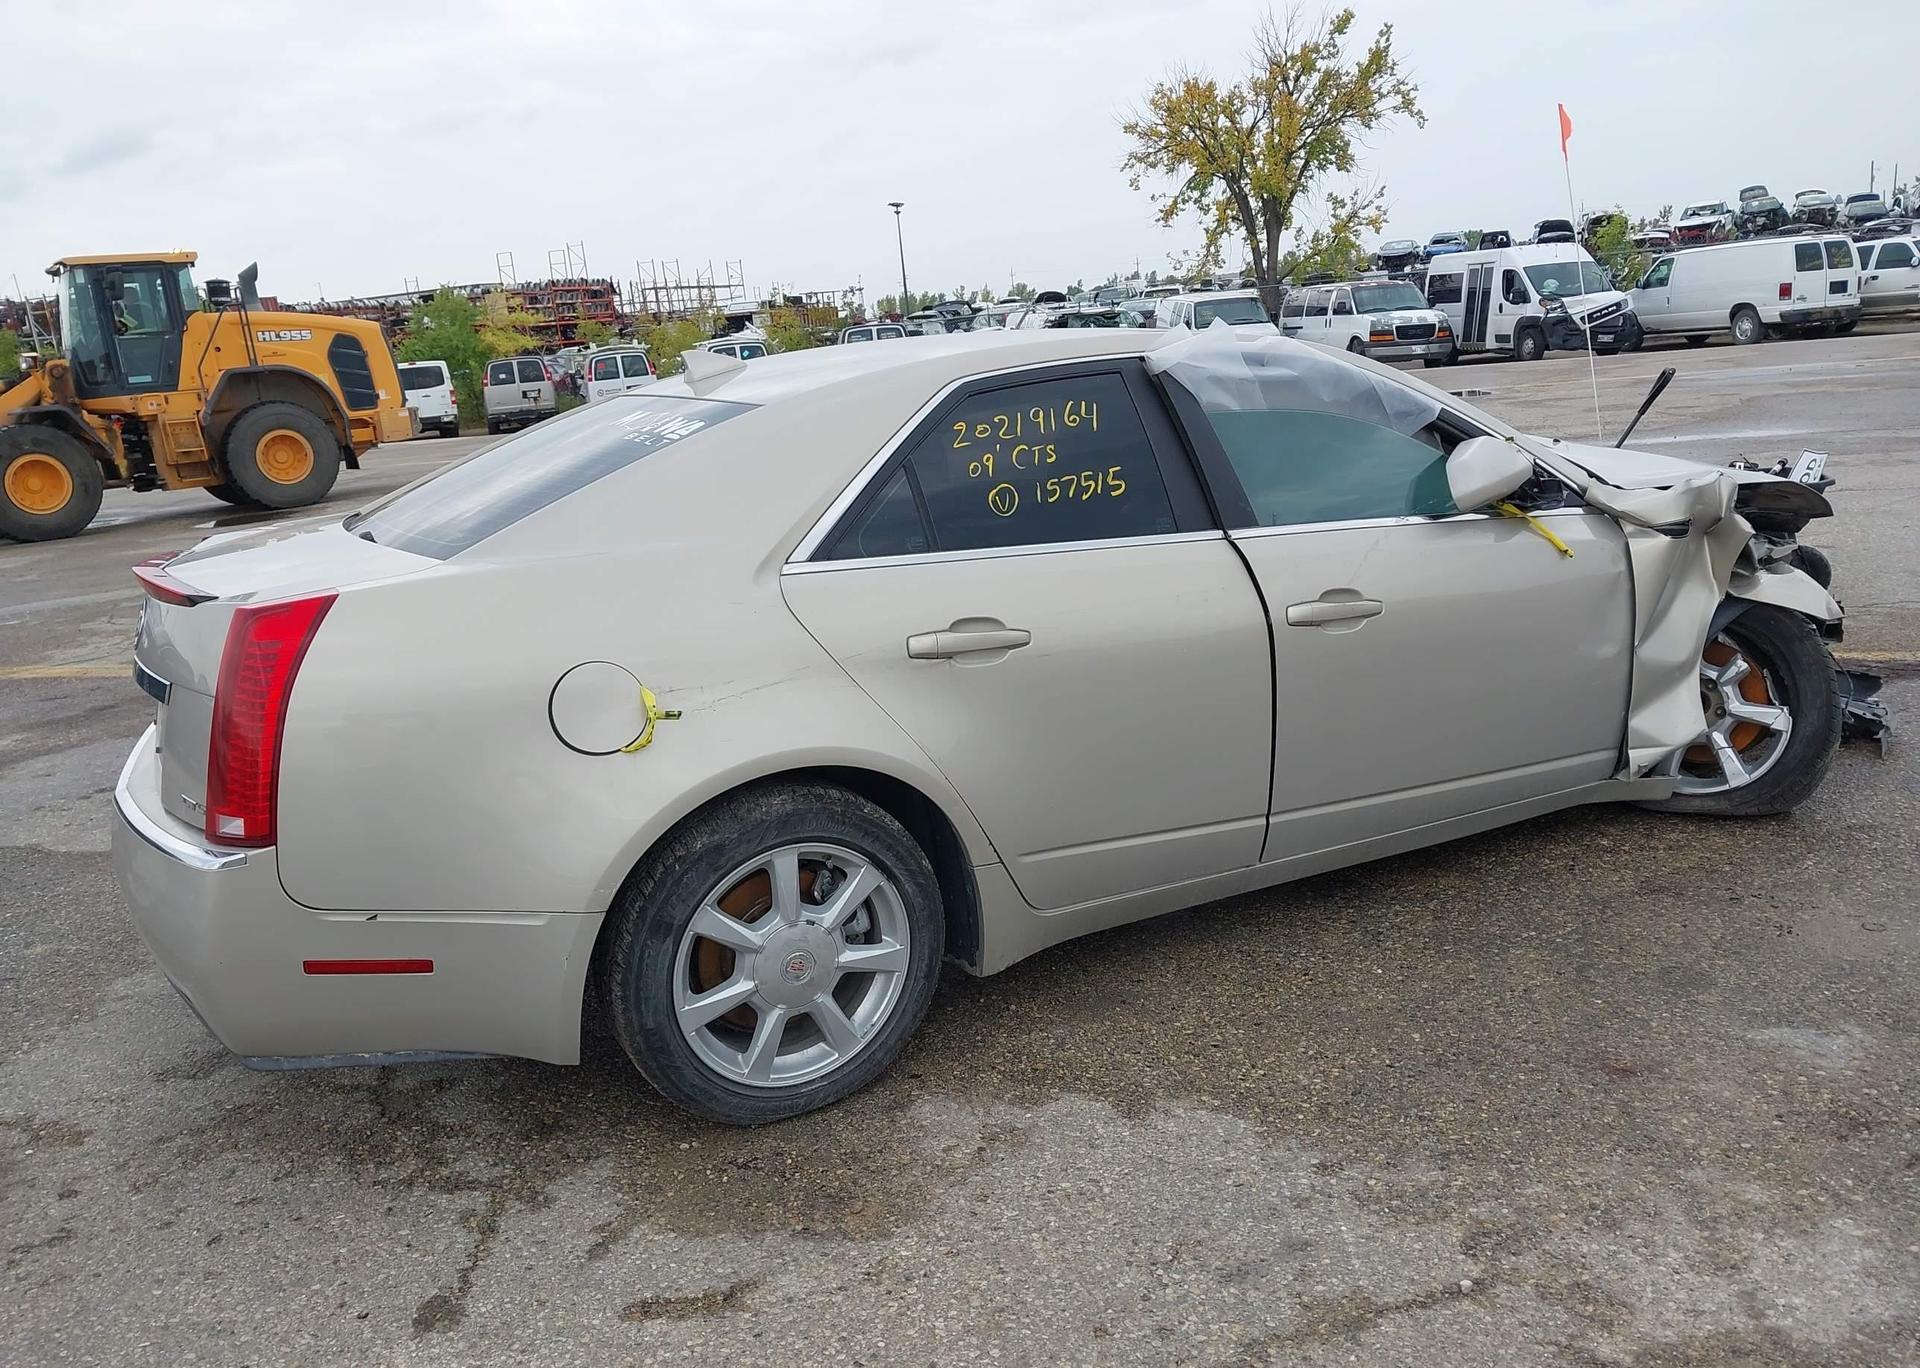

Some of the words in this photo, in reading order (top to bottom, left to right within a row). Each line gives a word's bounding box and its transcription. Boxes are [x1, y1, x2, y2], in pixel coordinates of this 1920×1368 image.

[256, 329, 312, 342] HL955
[953, 400, 1097, 448] 20219164
[1012, 444, 1057, 469] CTS
[1035, 466, 1126, 503] 157515
